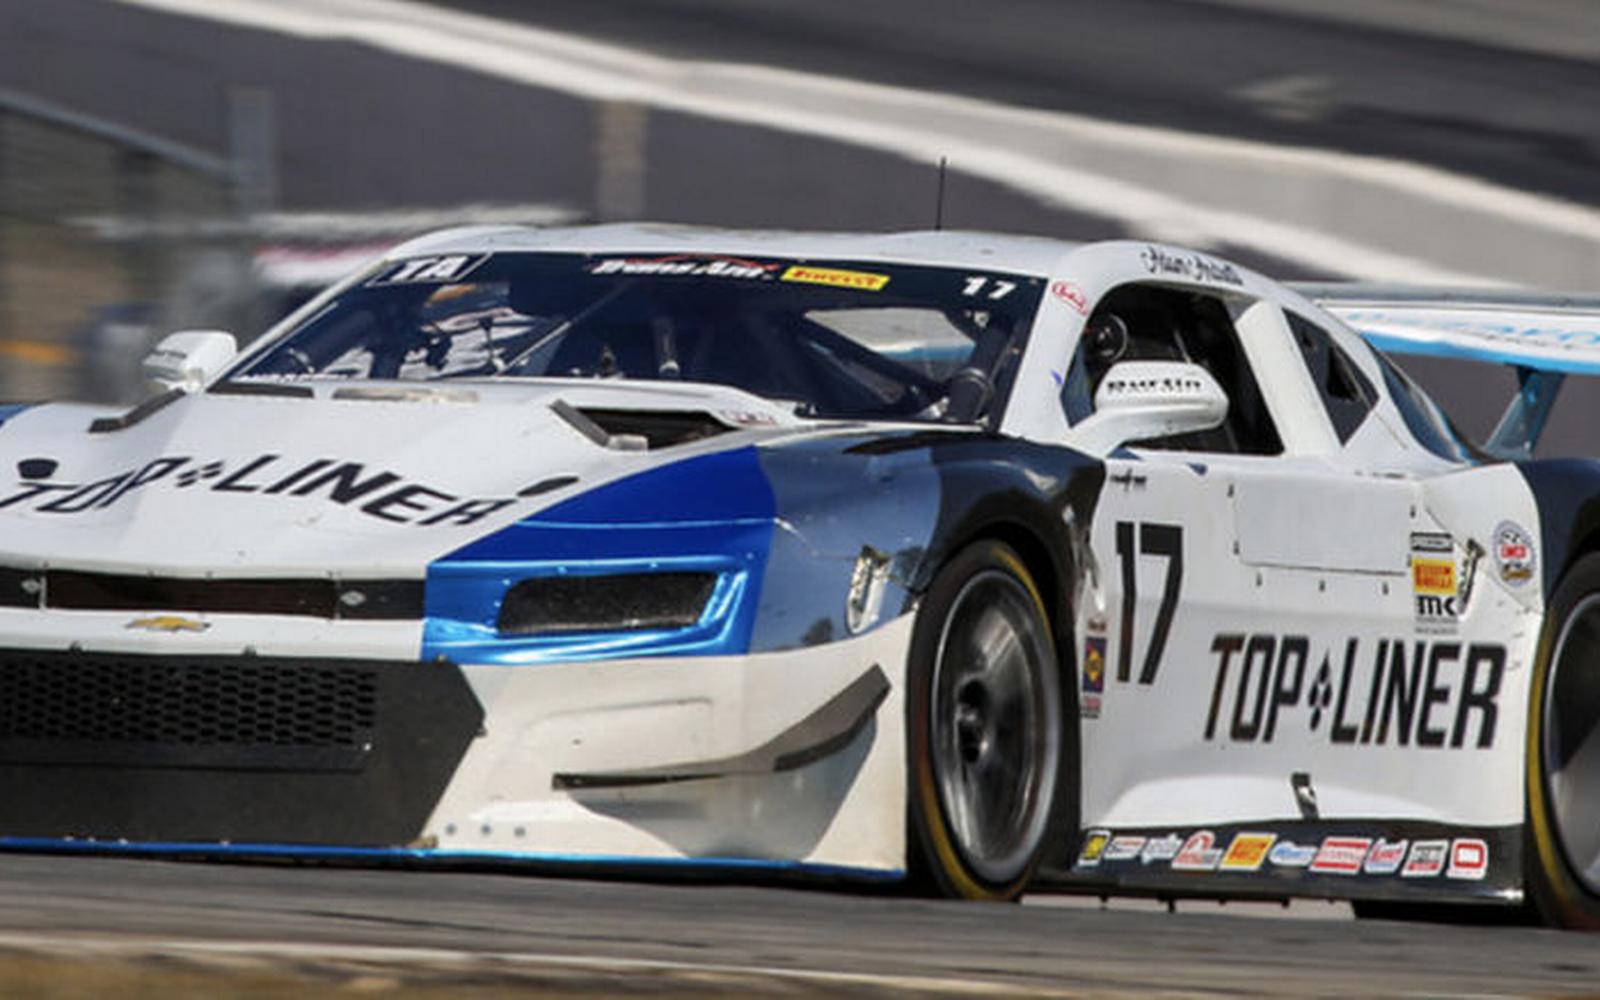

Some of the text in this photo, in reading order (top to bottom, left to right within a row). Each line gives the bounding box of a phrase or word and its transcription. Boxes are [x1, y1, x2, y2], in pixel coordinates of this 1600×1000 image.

[393, 256, 468, 280] TA
[960, 276, 1016, 300] 17
[0, 454, 519, 526] TOP LINER
[1115, 521, 1184, 685] 17
[1205, 634, 1508, 749] TOP LINER
